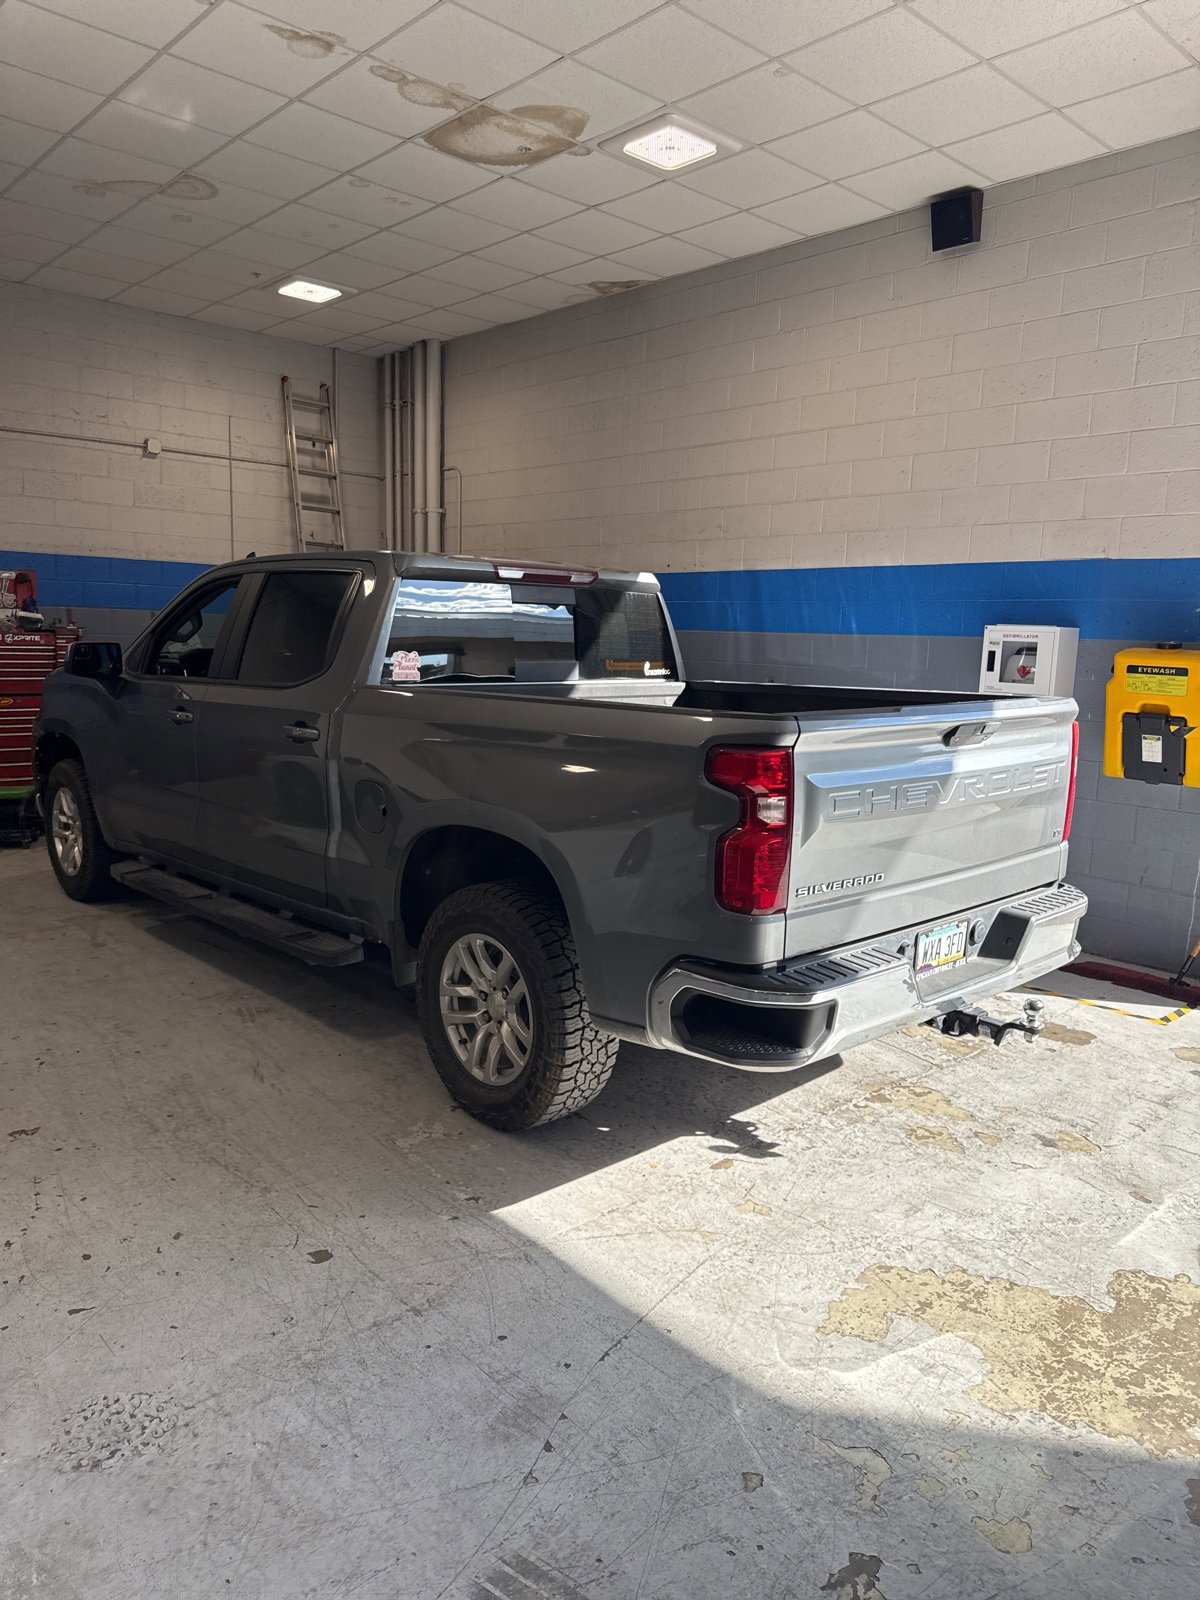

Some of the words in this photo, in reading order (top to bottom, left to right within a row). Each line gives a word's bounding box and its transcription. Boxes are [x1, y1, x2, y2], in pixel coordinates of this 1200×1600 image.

[1138, 666, 1176, 674] EYEWASH
[828, 760, 1066, 819] CHEVROLET
[795, 872, 885, 898] SILVERADO
